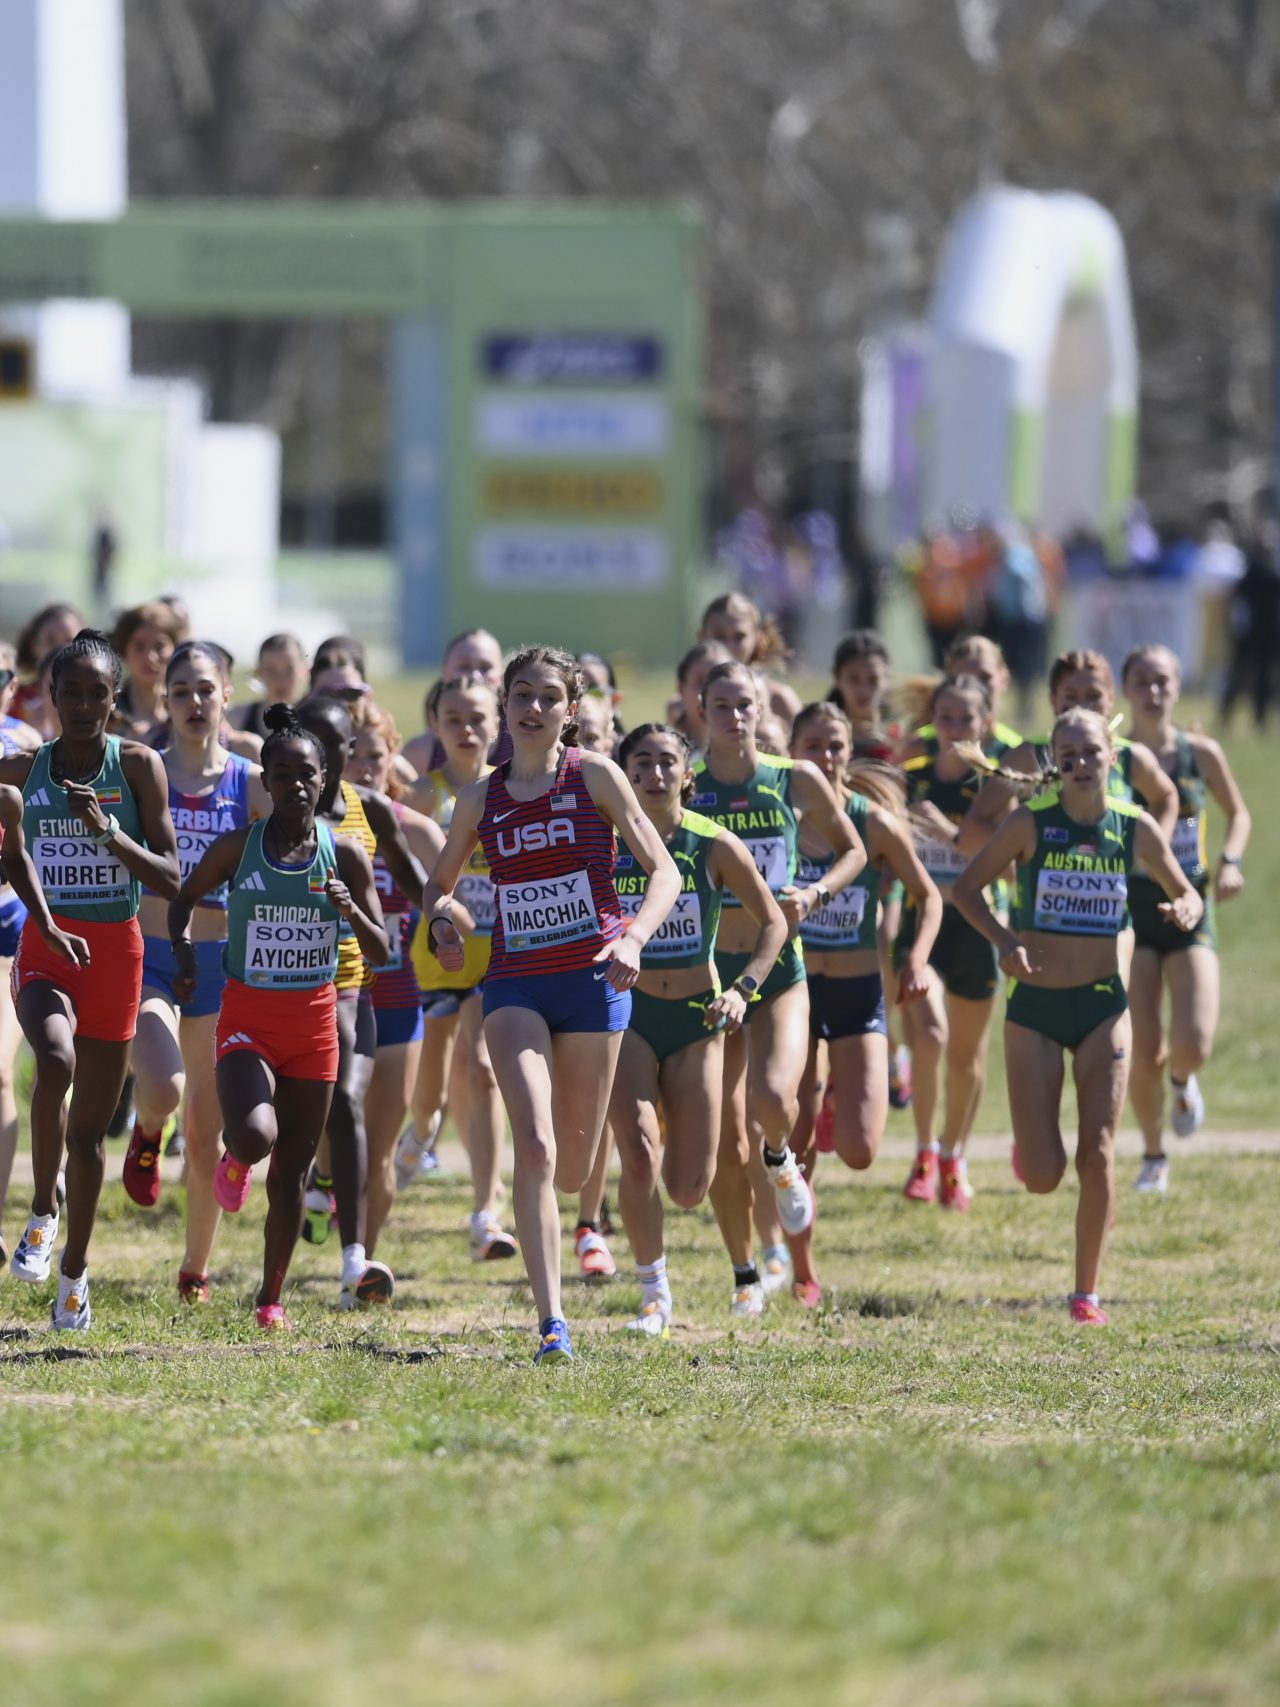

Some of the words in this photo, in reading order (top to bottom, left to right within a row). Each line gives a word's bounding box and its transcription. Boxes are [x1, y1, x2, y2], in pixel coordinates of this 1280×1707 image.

[39, 818, 88, 836] ETHIO
[170, 807, 236, 832] ERBIA
[496, 817, 576, 857] USA
[1043, 851, 1125, 875] AUSTRALIA
[42, 865, 120, 886] NIBRET
[1047, 874, 1119, 891] SONY
[60, 890, 111, 899] BELGRADE
[112, 889, 125, 897] 24
[506, 878, 578, 904] SONY
[255, 904, 320, 923] ETHIOPIA
[507, 898, 591, 932] MACCHIA
[1041, 894, 1121, 917] SCHMIDT
[256, 926, 331, 941] SONY
[529, 928, 579, 945] BELGRADE
[580, 922, 594, 931] 24
[251, 945, 330, 968] AYICHEW
[273, 973, 319, 982] BELGRADE
